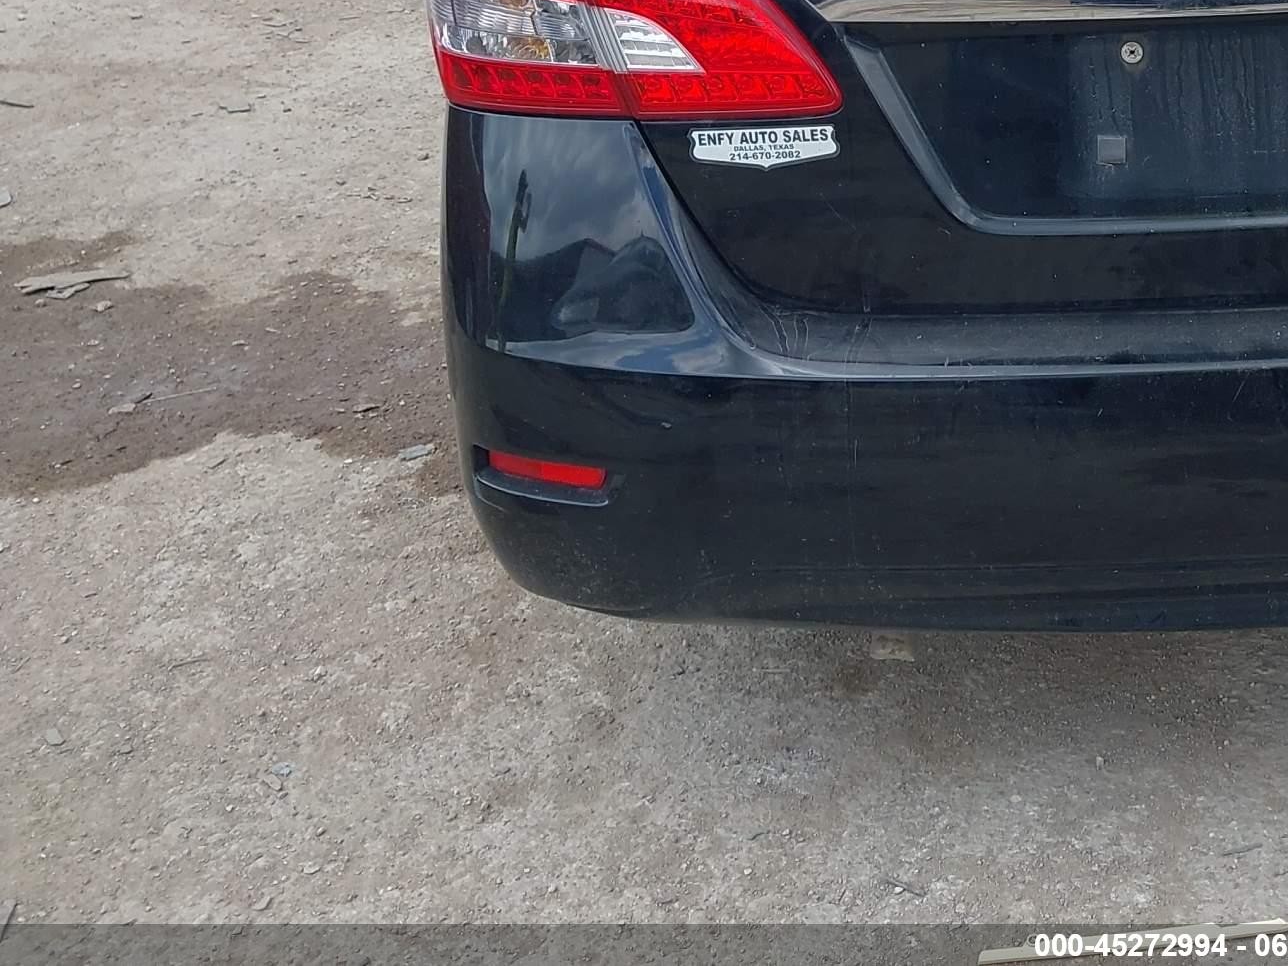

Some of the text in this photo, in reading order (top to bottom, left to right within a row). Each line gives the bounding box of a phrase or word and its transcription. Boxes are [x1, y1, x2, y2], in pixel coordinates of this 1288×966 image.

[697, 128, 829, 146] ENFY AUTO SALES
[733, 143, 795, 153] DALLAS, TEXAS
[729, 150, 801, 161] 214-670-2082
